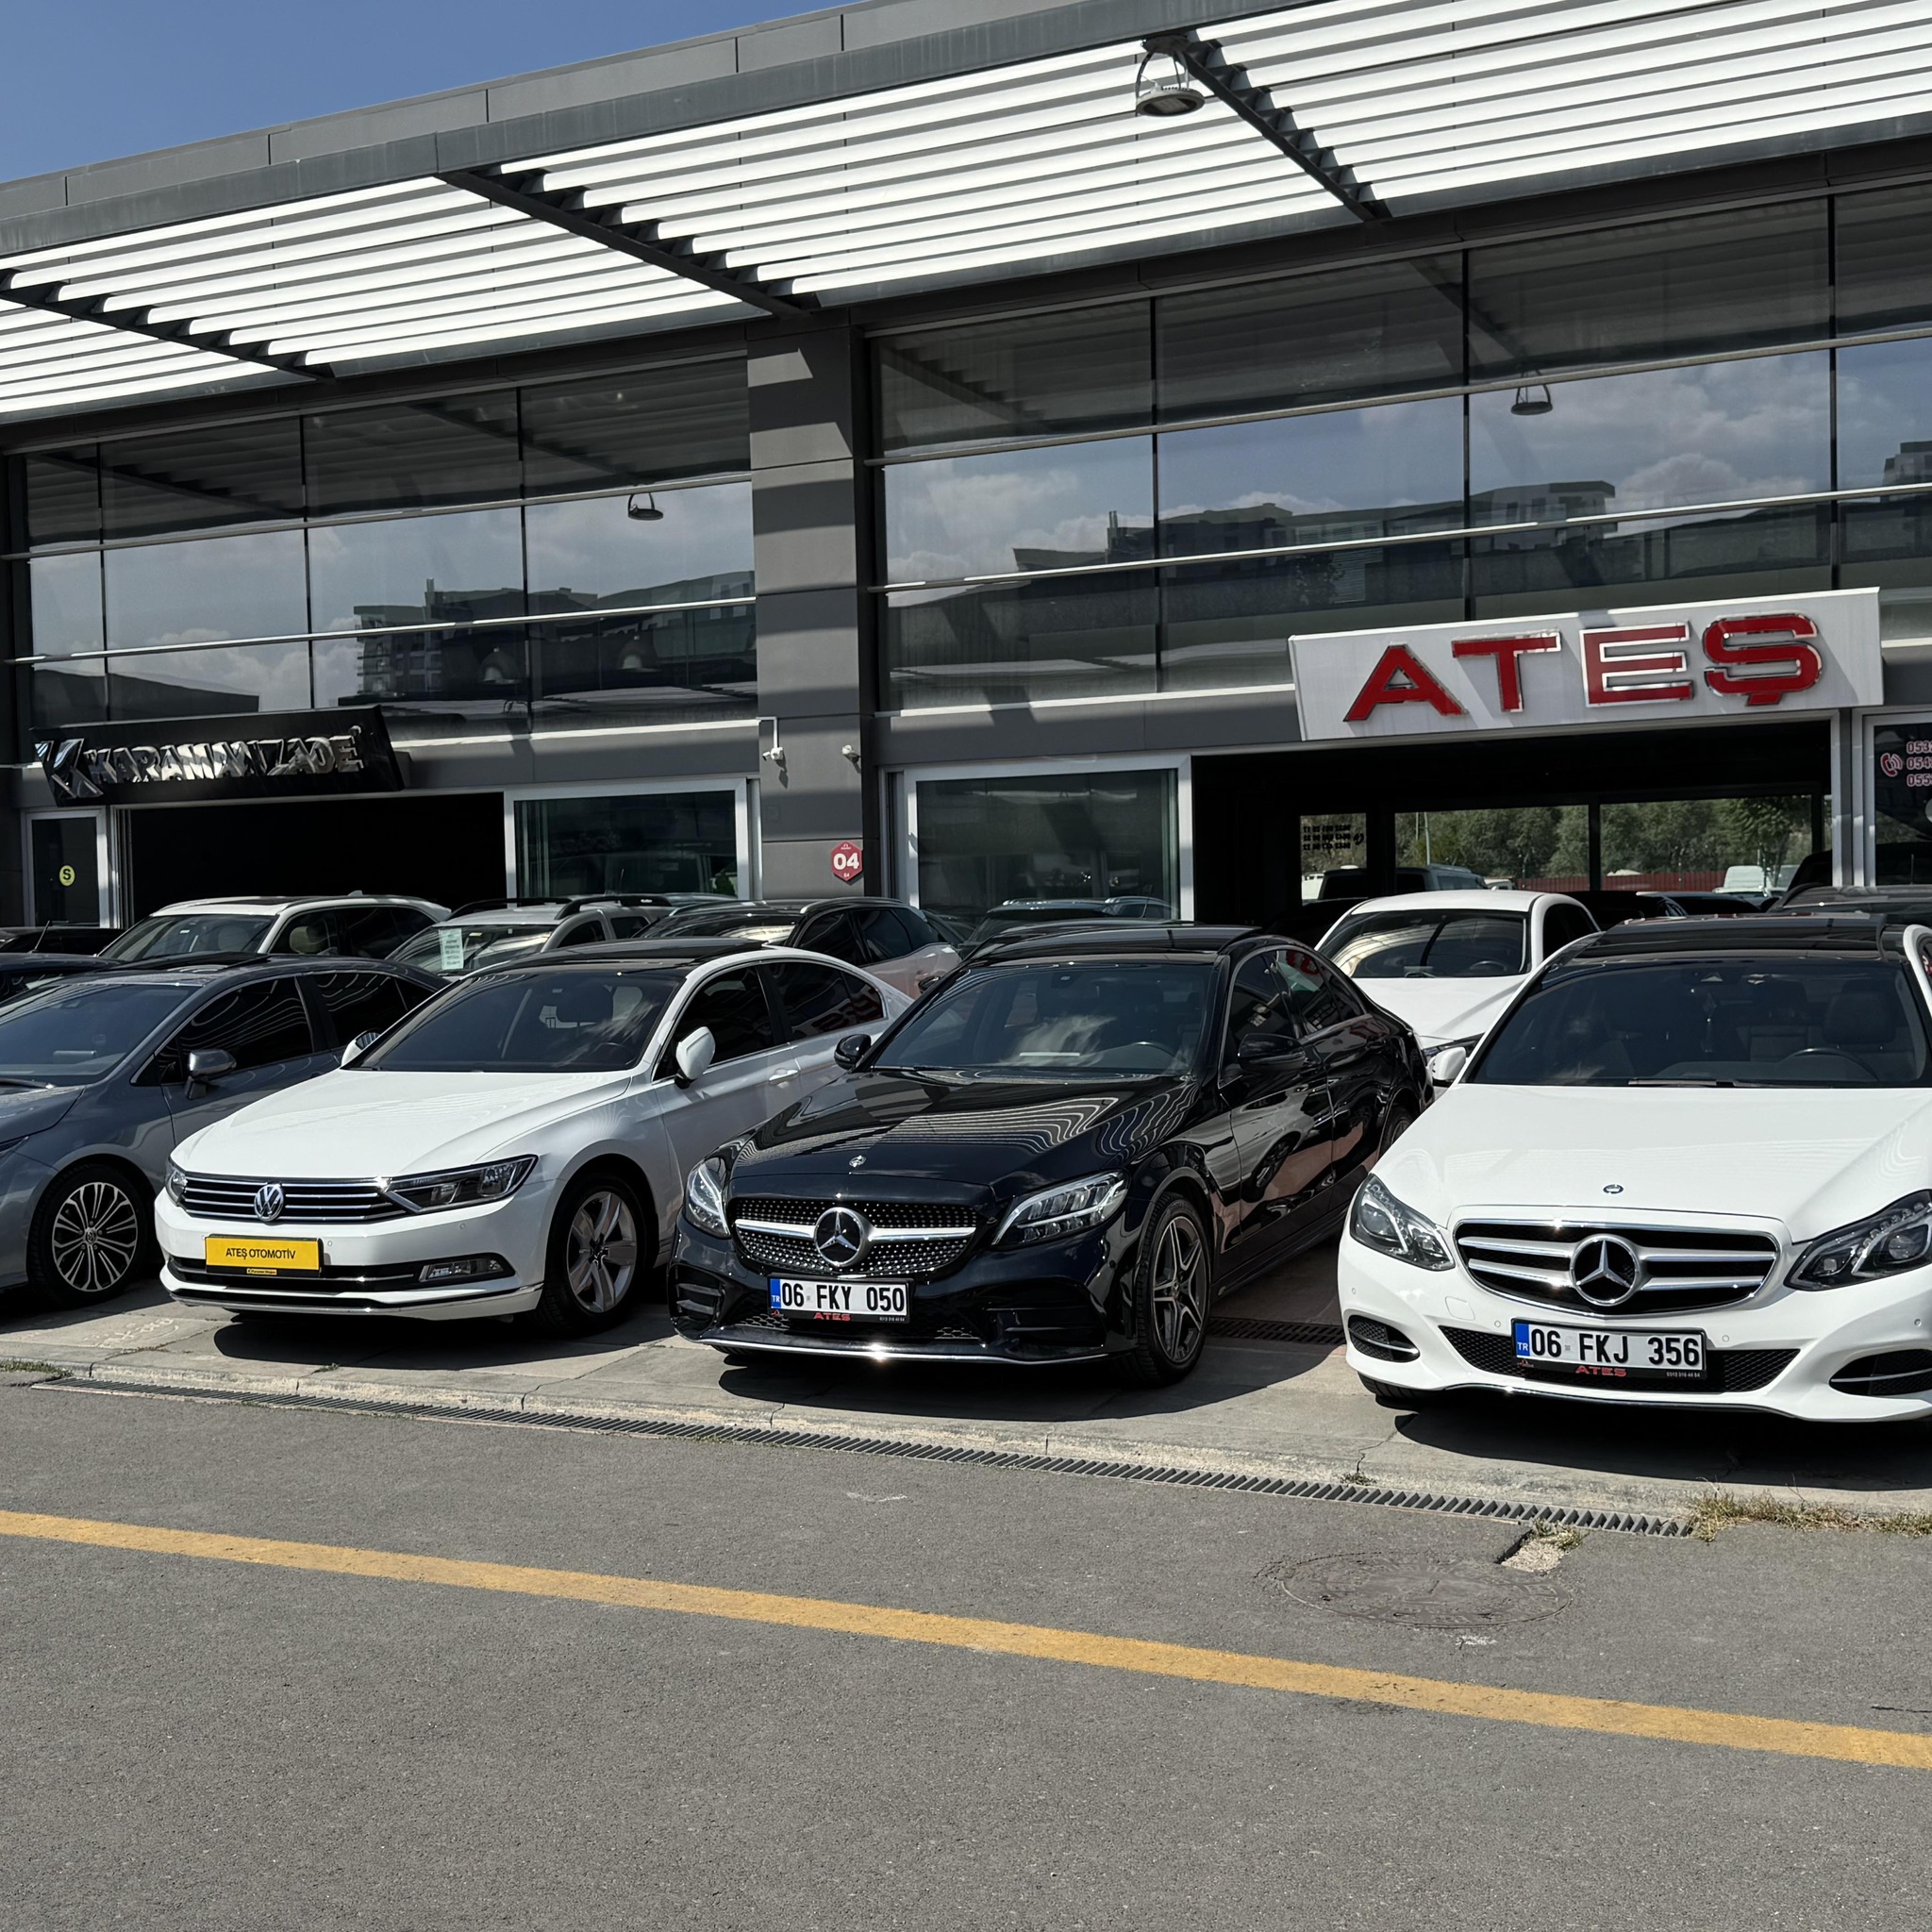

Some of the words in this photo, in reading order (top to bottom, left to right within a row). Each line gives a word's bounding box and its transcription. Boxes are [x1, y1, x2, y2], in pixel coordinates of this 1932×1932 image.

[1343, 613, 1823, 723] ATEŞ
[833, 852, 859, 870] 04
[62, 868, 72, 880] S
[225, 1247, 248, 1260] ATEŞ
[249, 1248, 296, 1259] OTOMOTİV
[772, 1294, 780, 1303] TR
[781, 1282, 805, 1307] 06
[816, 1284, 852, 1310] FKY
[866, 1287, 905, 1312] 050
[1517, 1341, 1528, 1352] TR
[1531, 1328, 1561, 1357] 06
[1579, 1333, 1629, 1364] FKJ
[1647, 1337, 1698, 1366] 356
